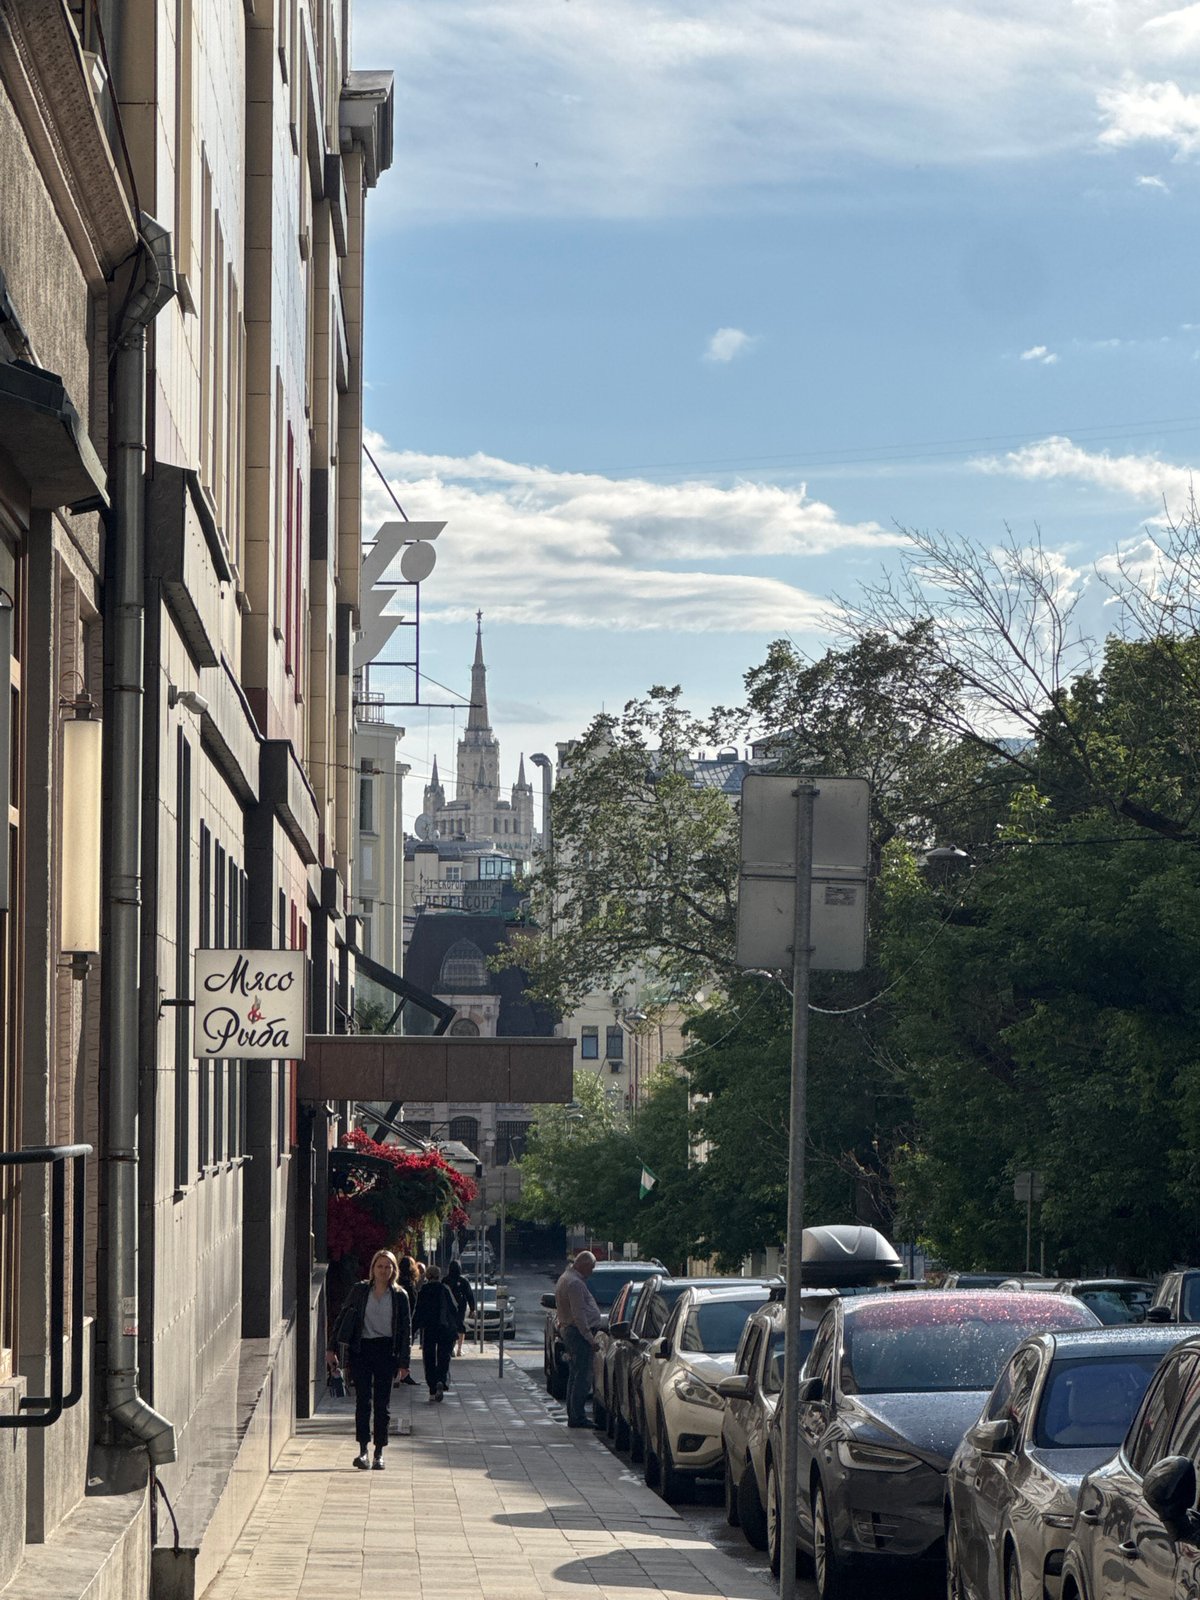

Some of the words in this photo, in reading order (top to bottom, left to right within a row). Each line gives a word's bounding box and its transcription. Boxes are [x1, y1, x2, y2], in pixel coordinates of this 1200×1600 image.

[204, 954, 295, 997] Мясо
[203, 1006, 290, 1054] Рыба
[247, 1000, 266, 1024] &
